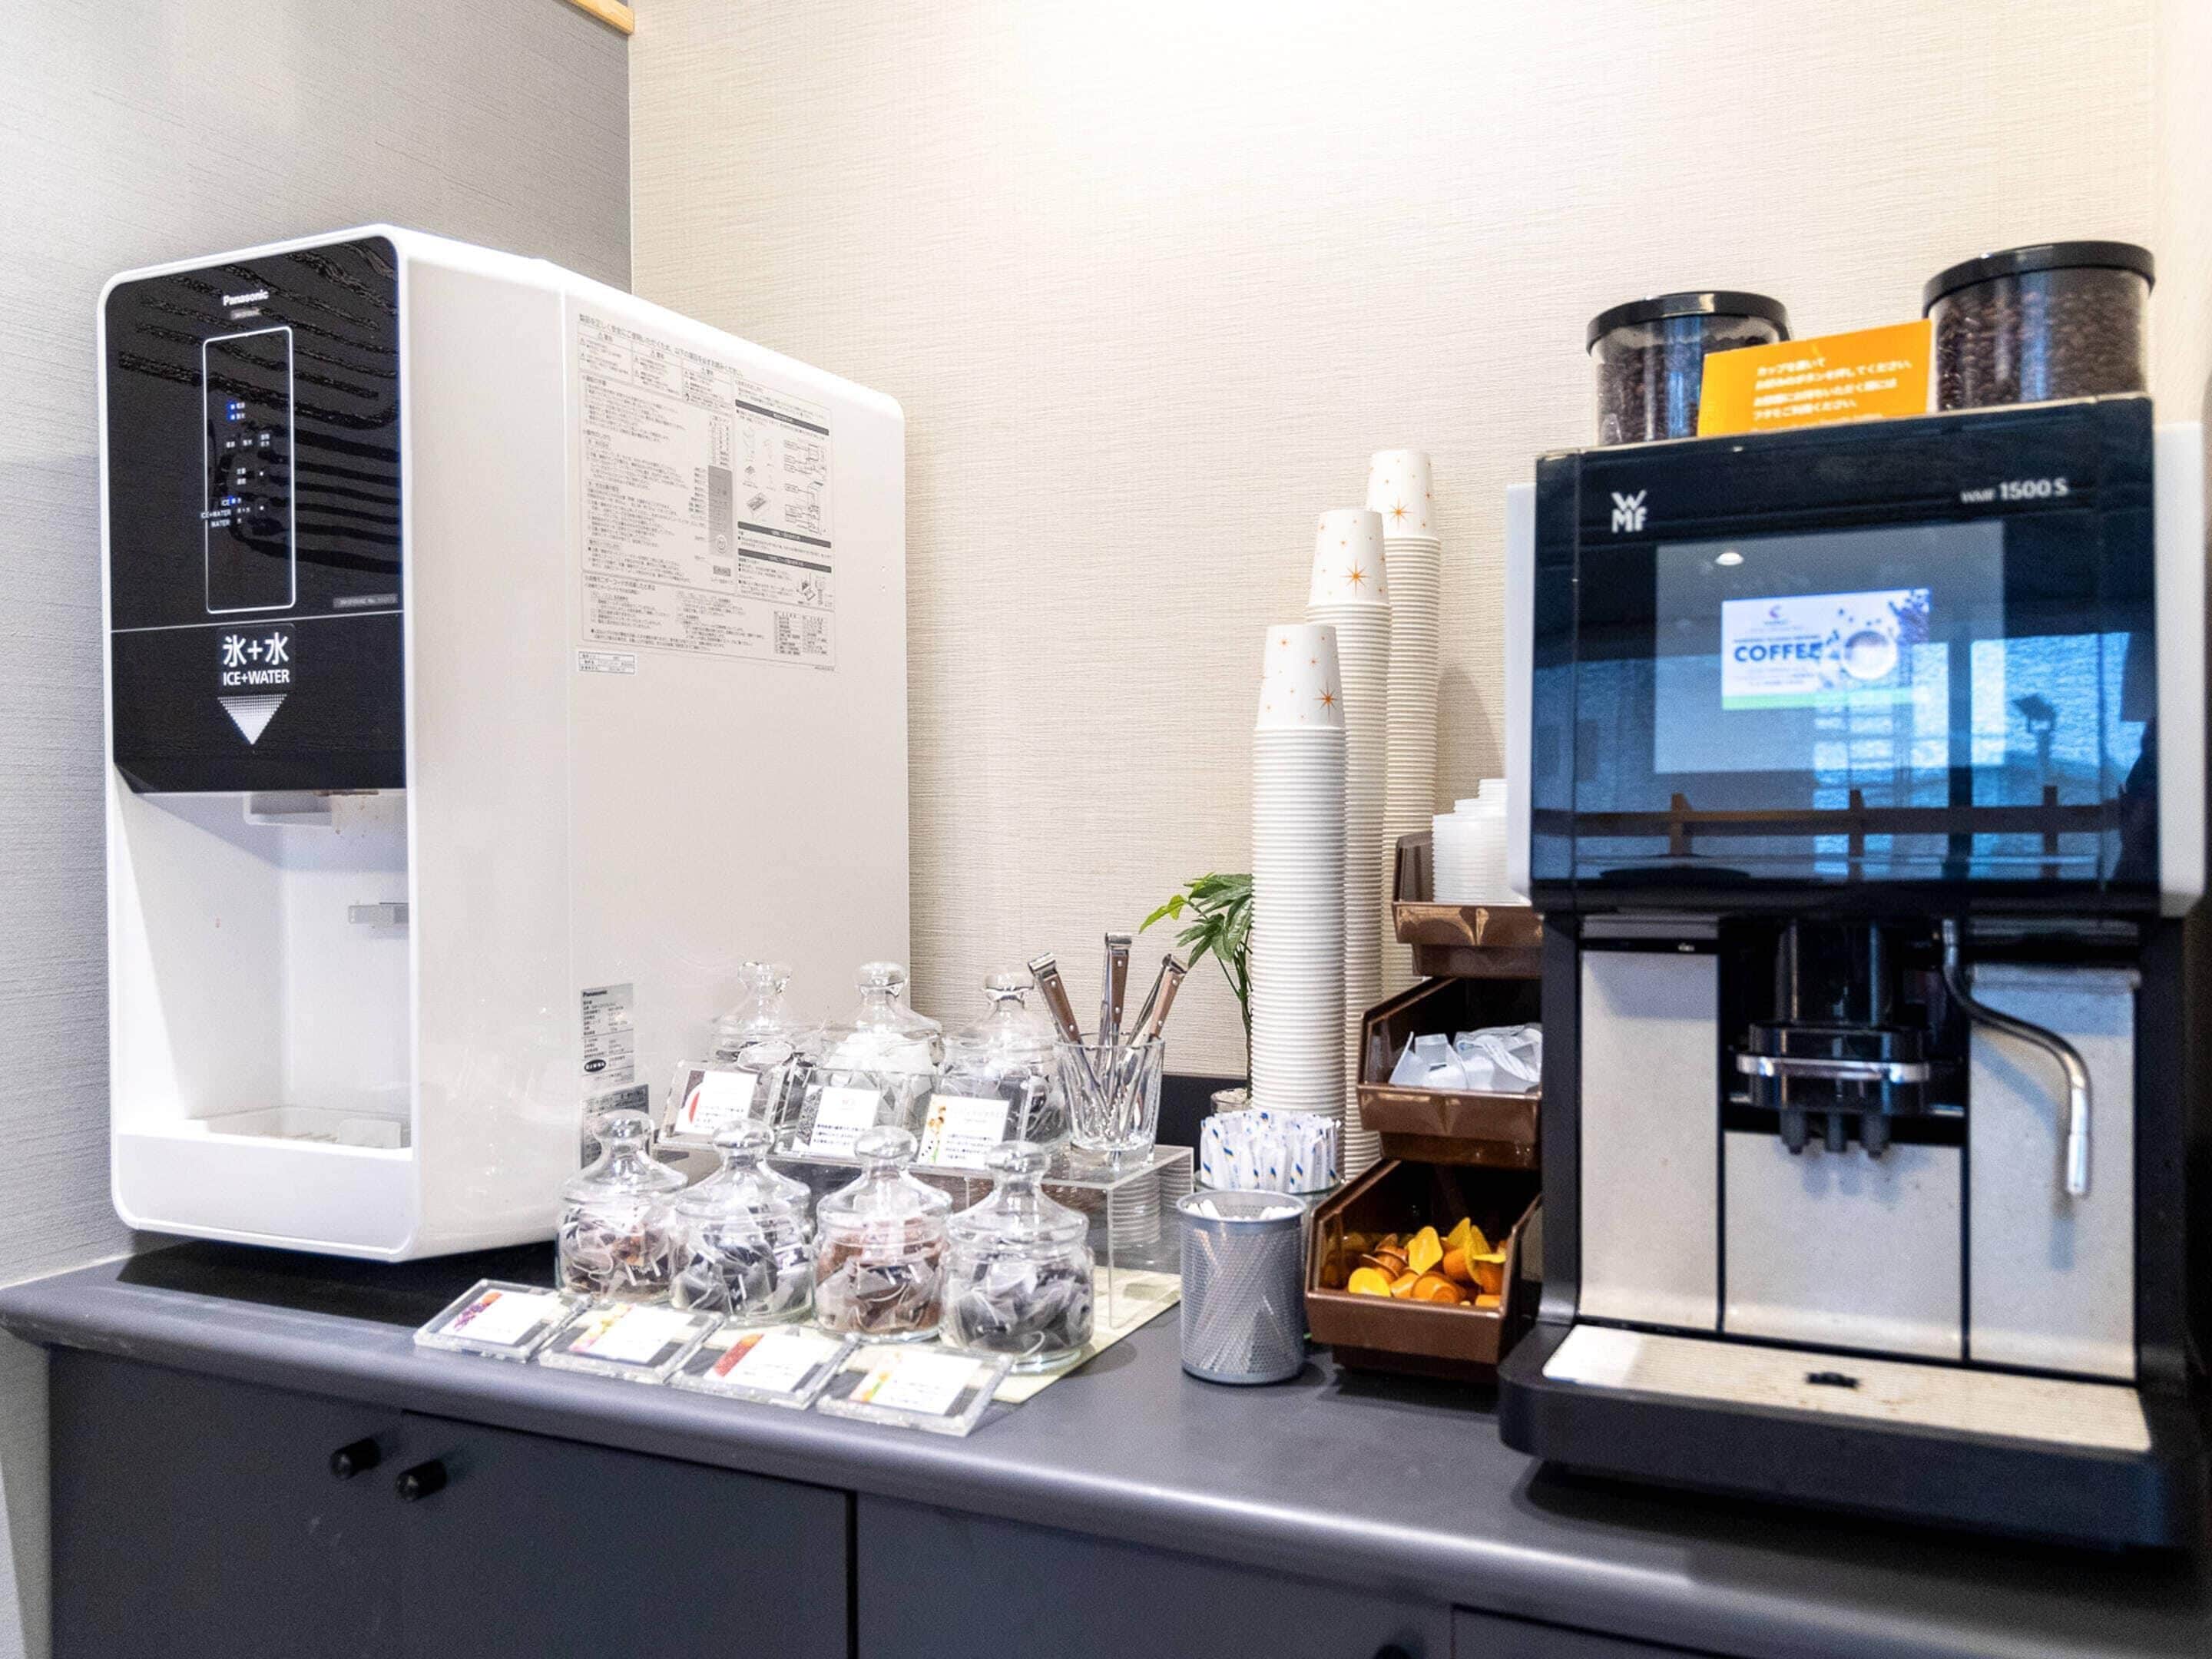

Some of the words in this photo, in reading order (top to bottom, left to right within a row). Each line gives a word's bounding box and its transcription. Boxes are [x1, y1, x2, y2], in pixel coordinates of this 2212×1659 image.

[223, 289, 270, 306] Panasonic
[1999, 478, 2052, 501] 1500
[2053, 477, 2070, 497] S
[1734, 642, 1823, 662] COFFEE
[223, 669, 290, 686] ICE+WATER
